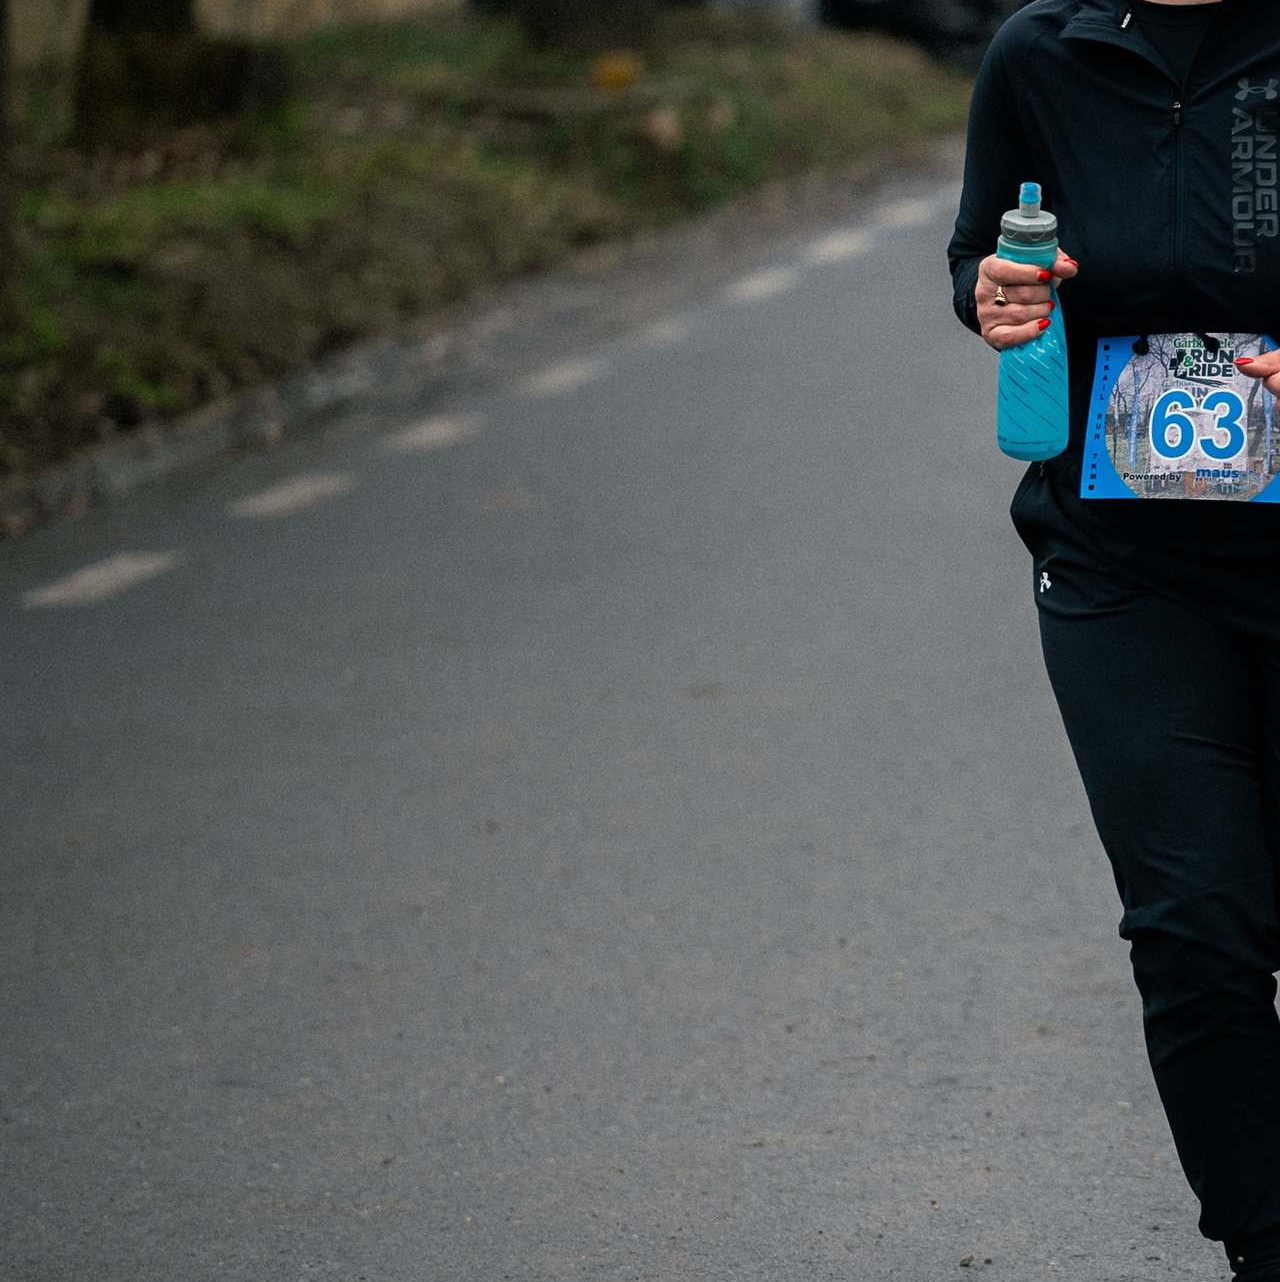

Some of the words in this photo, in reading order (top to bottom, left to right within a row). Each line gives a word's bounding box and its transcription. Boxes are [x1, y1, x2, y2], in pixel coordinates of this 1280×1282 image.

[1255, 108, 1279, 238] UNDER
[1231, 106, 1257, 273] ARMOUR
[1183, 356, 1194, 368] &
[1190, 349, 1234, 364] RUN
[1100, 355, 1111, 401] TRAIL
[1189, 363, 1233, 377] RIDE
[1094, 413, 1102, 440] RUN
[1151, 389, 1245, 461] 63
[1122, 472, 1167, 482] Powered
[1169, 471, 1182, 483] by
[1196, 468, 1239, 479] maus
